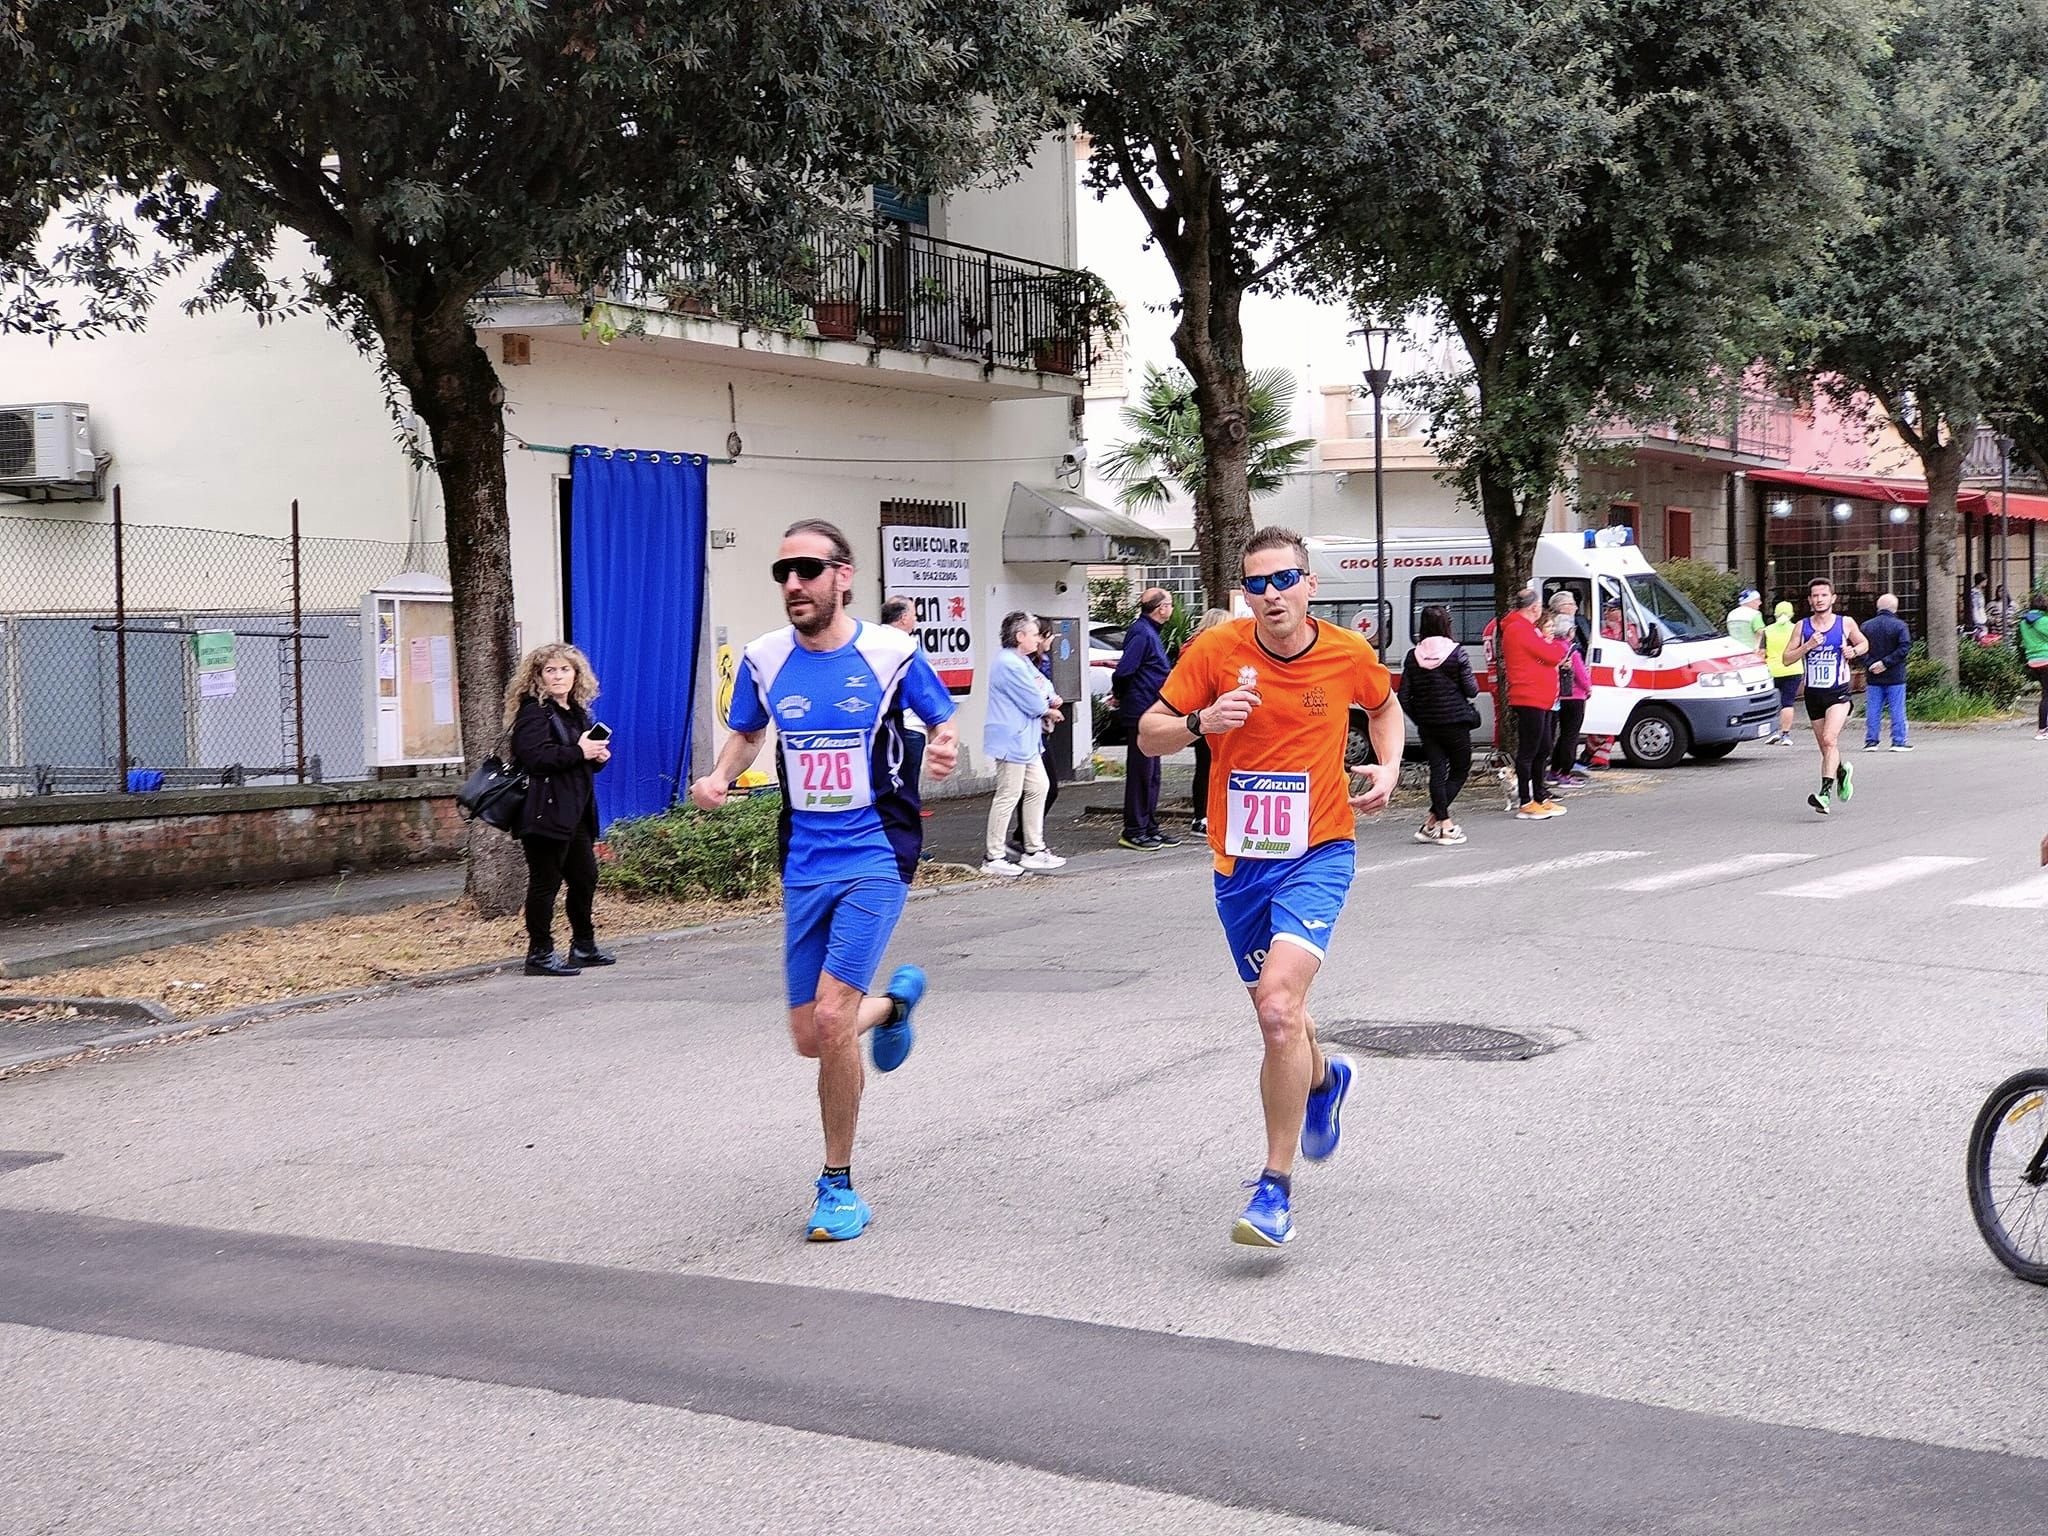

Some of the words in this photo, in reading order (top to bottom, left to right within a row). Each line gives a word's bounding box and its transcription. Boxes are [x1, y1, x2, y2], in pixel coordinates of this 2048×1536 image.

[1394, 557, 1442, 567] ROSSA
[1814, 666, 1830, 680] 118
[800, 752, 852, 790] 226
[1244, 794, 1291, 836] 216
